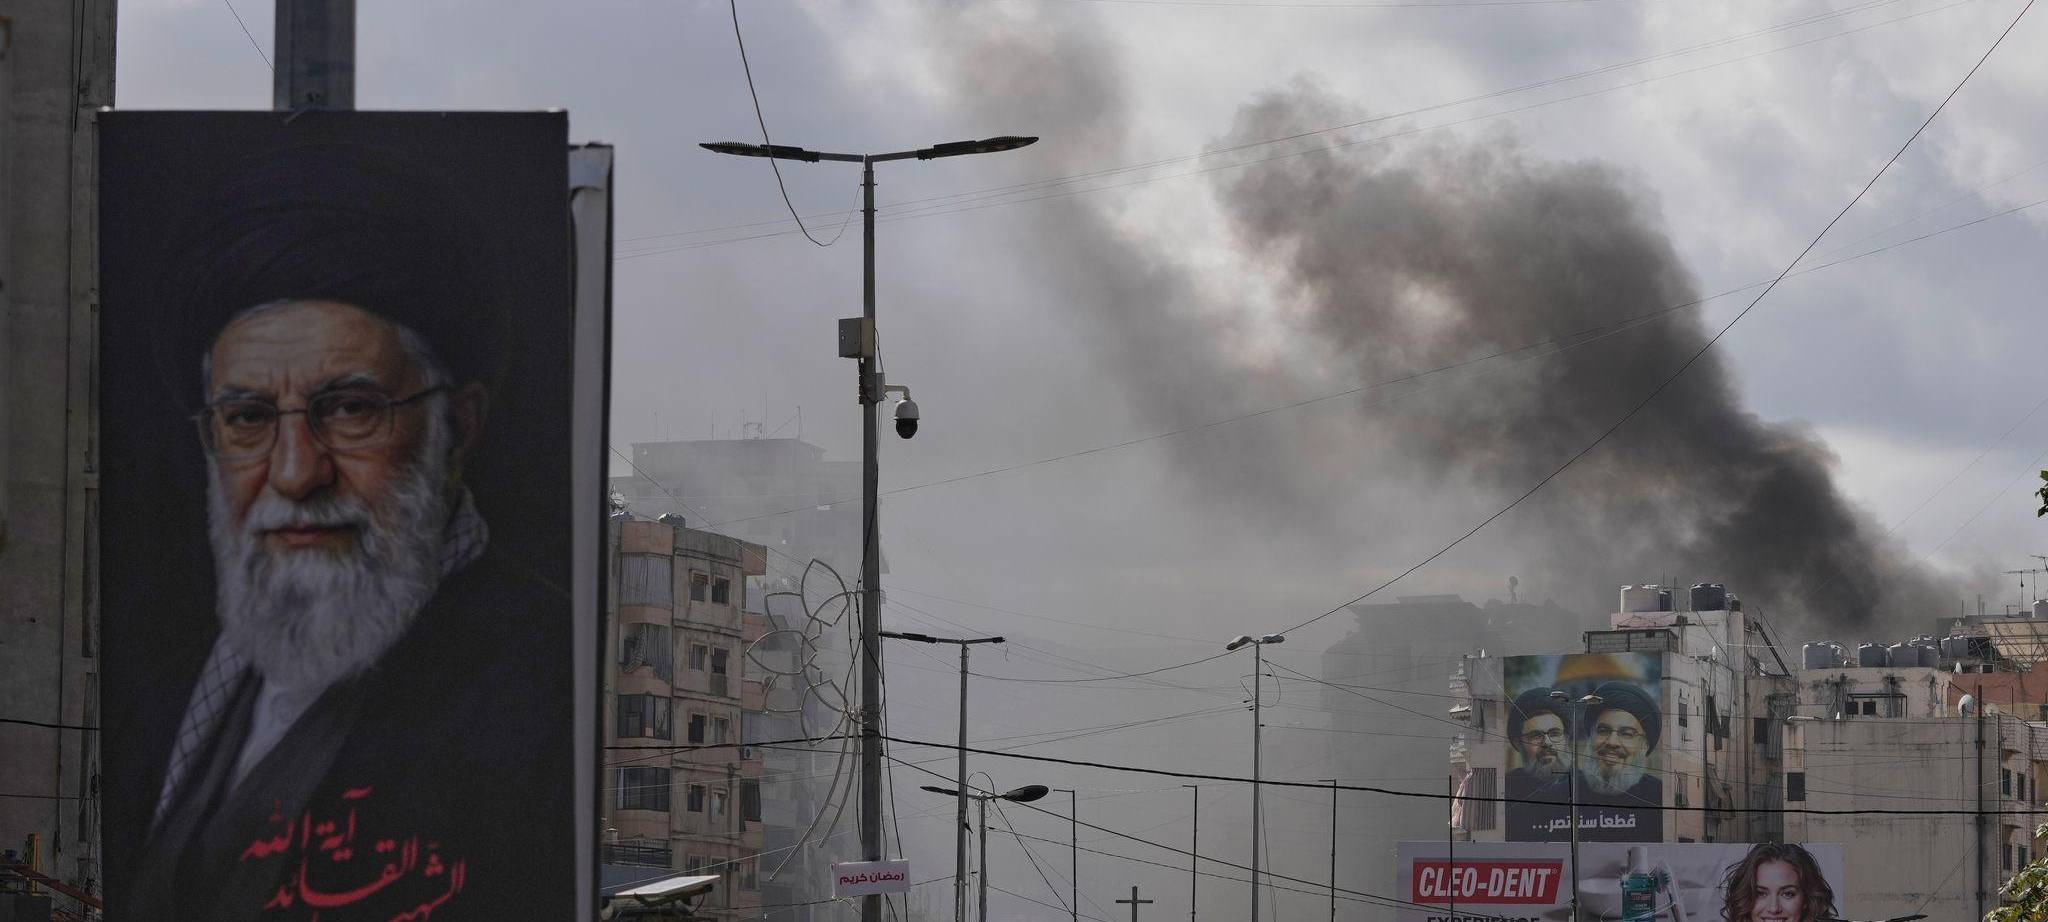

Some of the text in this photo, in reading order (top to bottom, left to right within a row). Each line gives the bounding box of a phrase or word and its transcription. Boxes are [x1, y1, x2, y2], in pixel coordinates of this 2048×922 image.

[239, 785, 374, 863] آية الله
[263, 833, 419, 911] القائد
[839, 871, 905, 885] رمضان كريم
[1418, 866, 1552, 898] CLEO-DENT
